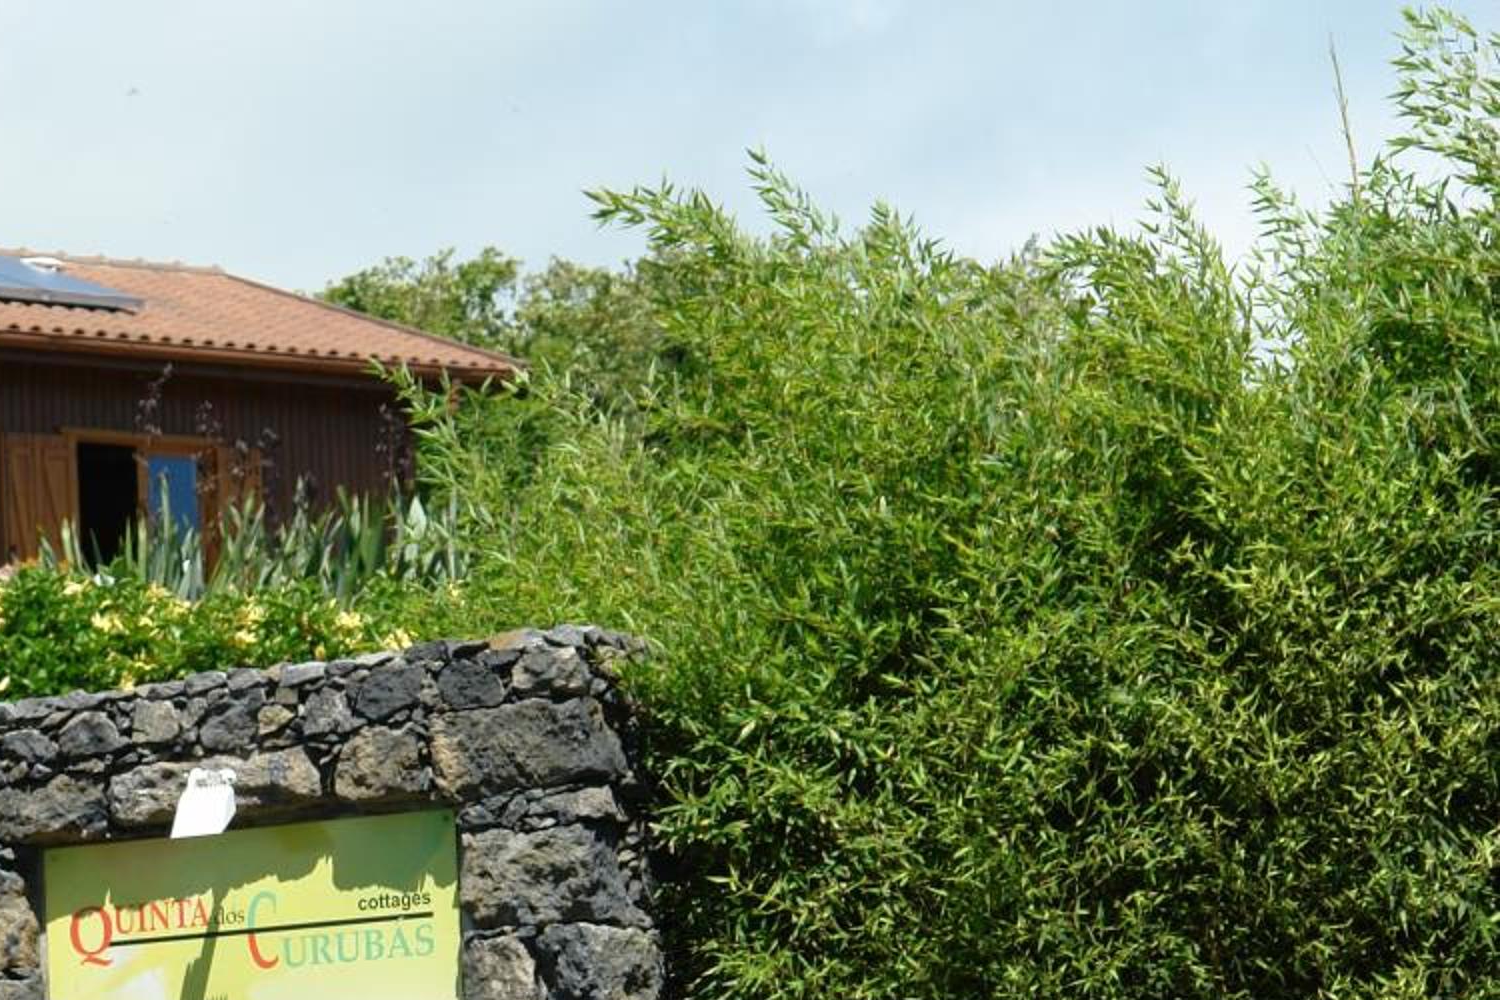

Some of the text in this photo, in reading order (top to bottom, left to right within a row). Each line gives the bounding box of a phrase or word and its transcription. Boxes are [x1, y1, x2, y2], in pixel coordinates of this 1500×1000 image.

[358, 892, 431, 911] cottages
[70, 896, 210, 966] QUINTA
[212, 904, 245, 926] dos
